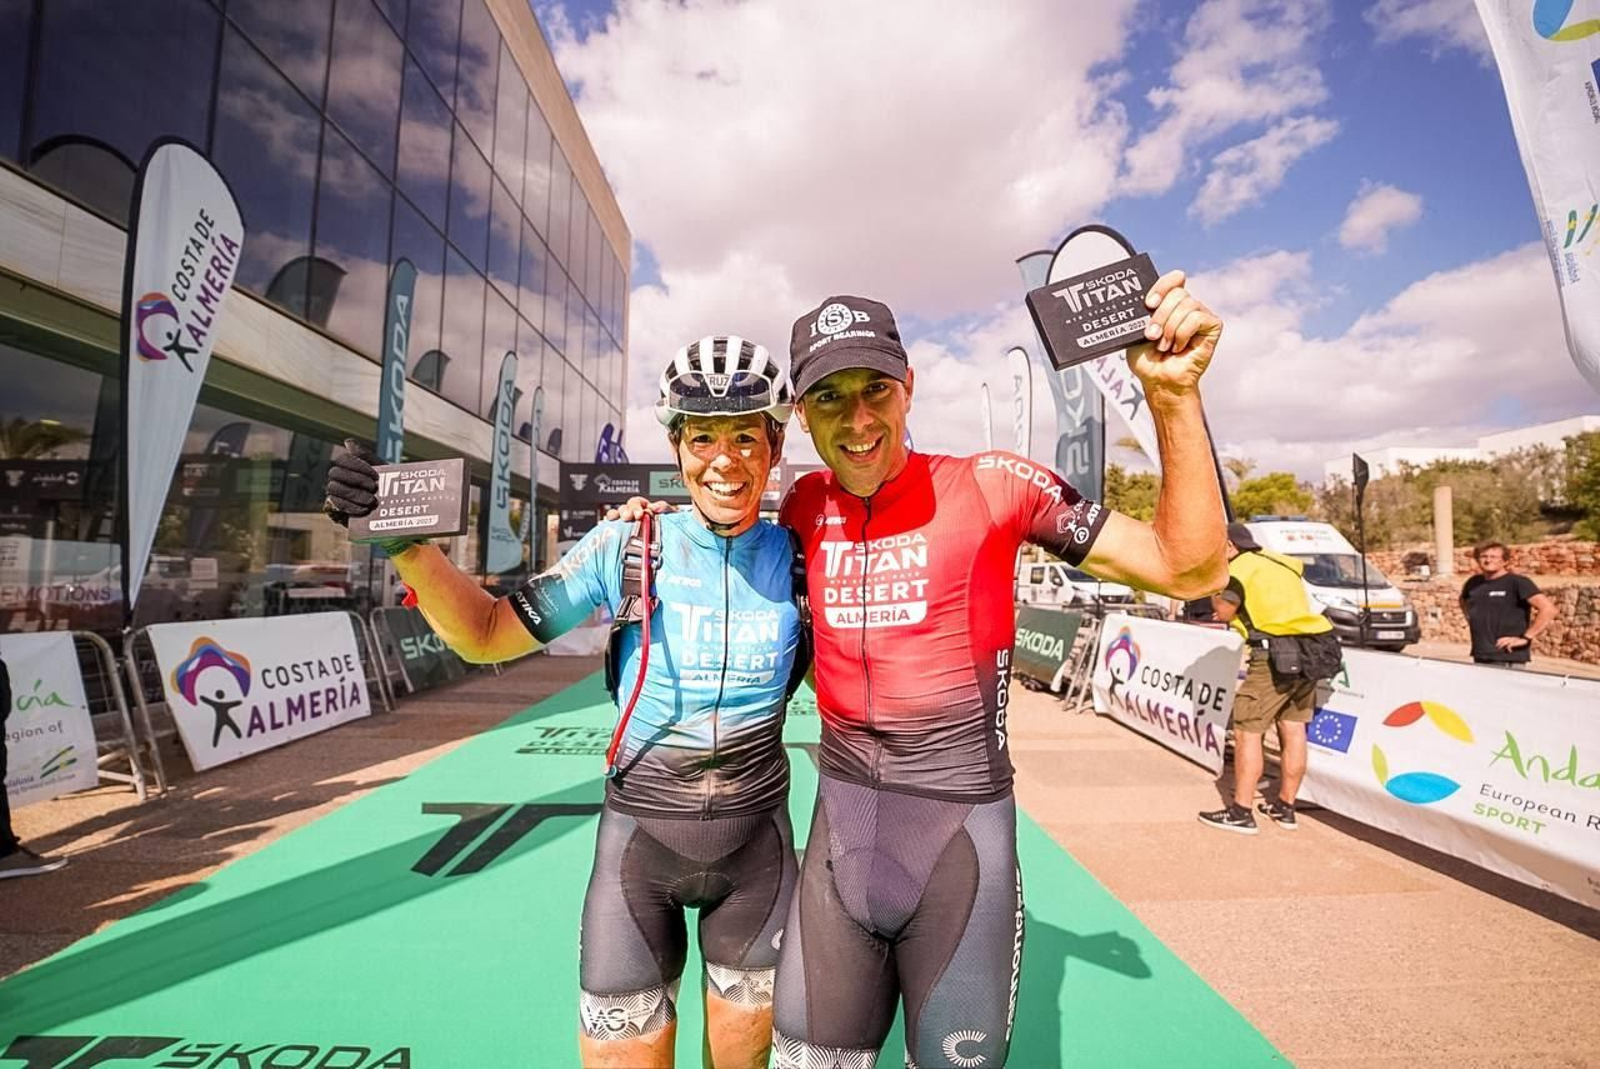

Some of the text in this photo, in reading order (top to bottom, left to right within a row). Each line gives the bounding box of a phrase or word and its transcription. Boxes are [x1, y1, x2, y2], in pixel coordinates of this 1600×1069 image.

[171, 208, 215, 302] COSTA DE
[186, 233, 239, 347] ALMERÍA
[1051, 276, 1142, 313] TITAN
[1085, 268, 1137, 290] SKODA
[1082, 308, 1135, 332] DESERT
[1083, 326, 1127, 345] ALMERÍA
[497, 380, 514, 509] SKODA
[378, 471, 446, 497] TITAN
[400, 469, 447, 480] SKODA
[977, 455, 1063, 505] SKODA
[374, 519, 414, 529] ALMERÍA
[380, 504, 430, 517] DESERT
[820, 541, 928, 578] TITAN
[855, 533, 927, 554] SKODA
[824, 579, 929, 604] DESERT
[669, 601, 779, 642] TITAN
[714, 608, 779, 620] SKODA
[836, 606, 911, 624] ALMERÍA
[401, 633, 450, 660] SKO
[1015, 628, 1065, 661] SKODA
[261, 653, 355, 690] COSTA DE
[681, 652, 779, 670] DESERT
[995, 649, 1009, 751] SKODA
[1141, 665, 1227, 711] COSTA DE
[246, 677, 361, 738] ALMERÍA
[1125, 691, 1221, 756] ALMERÍA
[4, 720, 63, 743] egion of
[1489, 729, 1600, 789] Anda
[1473, 803, 1547, 835] SPORT
[1479, 783, 1577, 824] European
